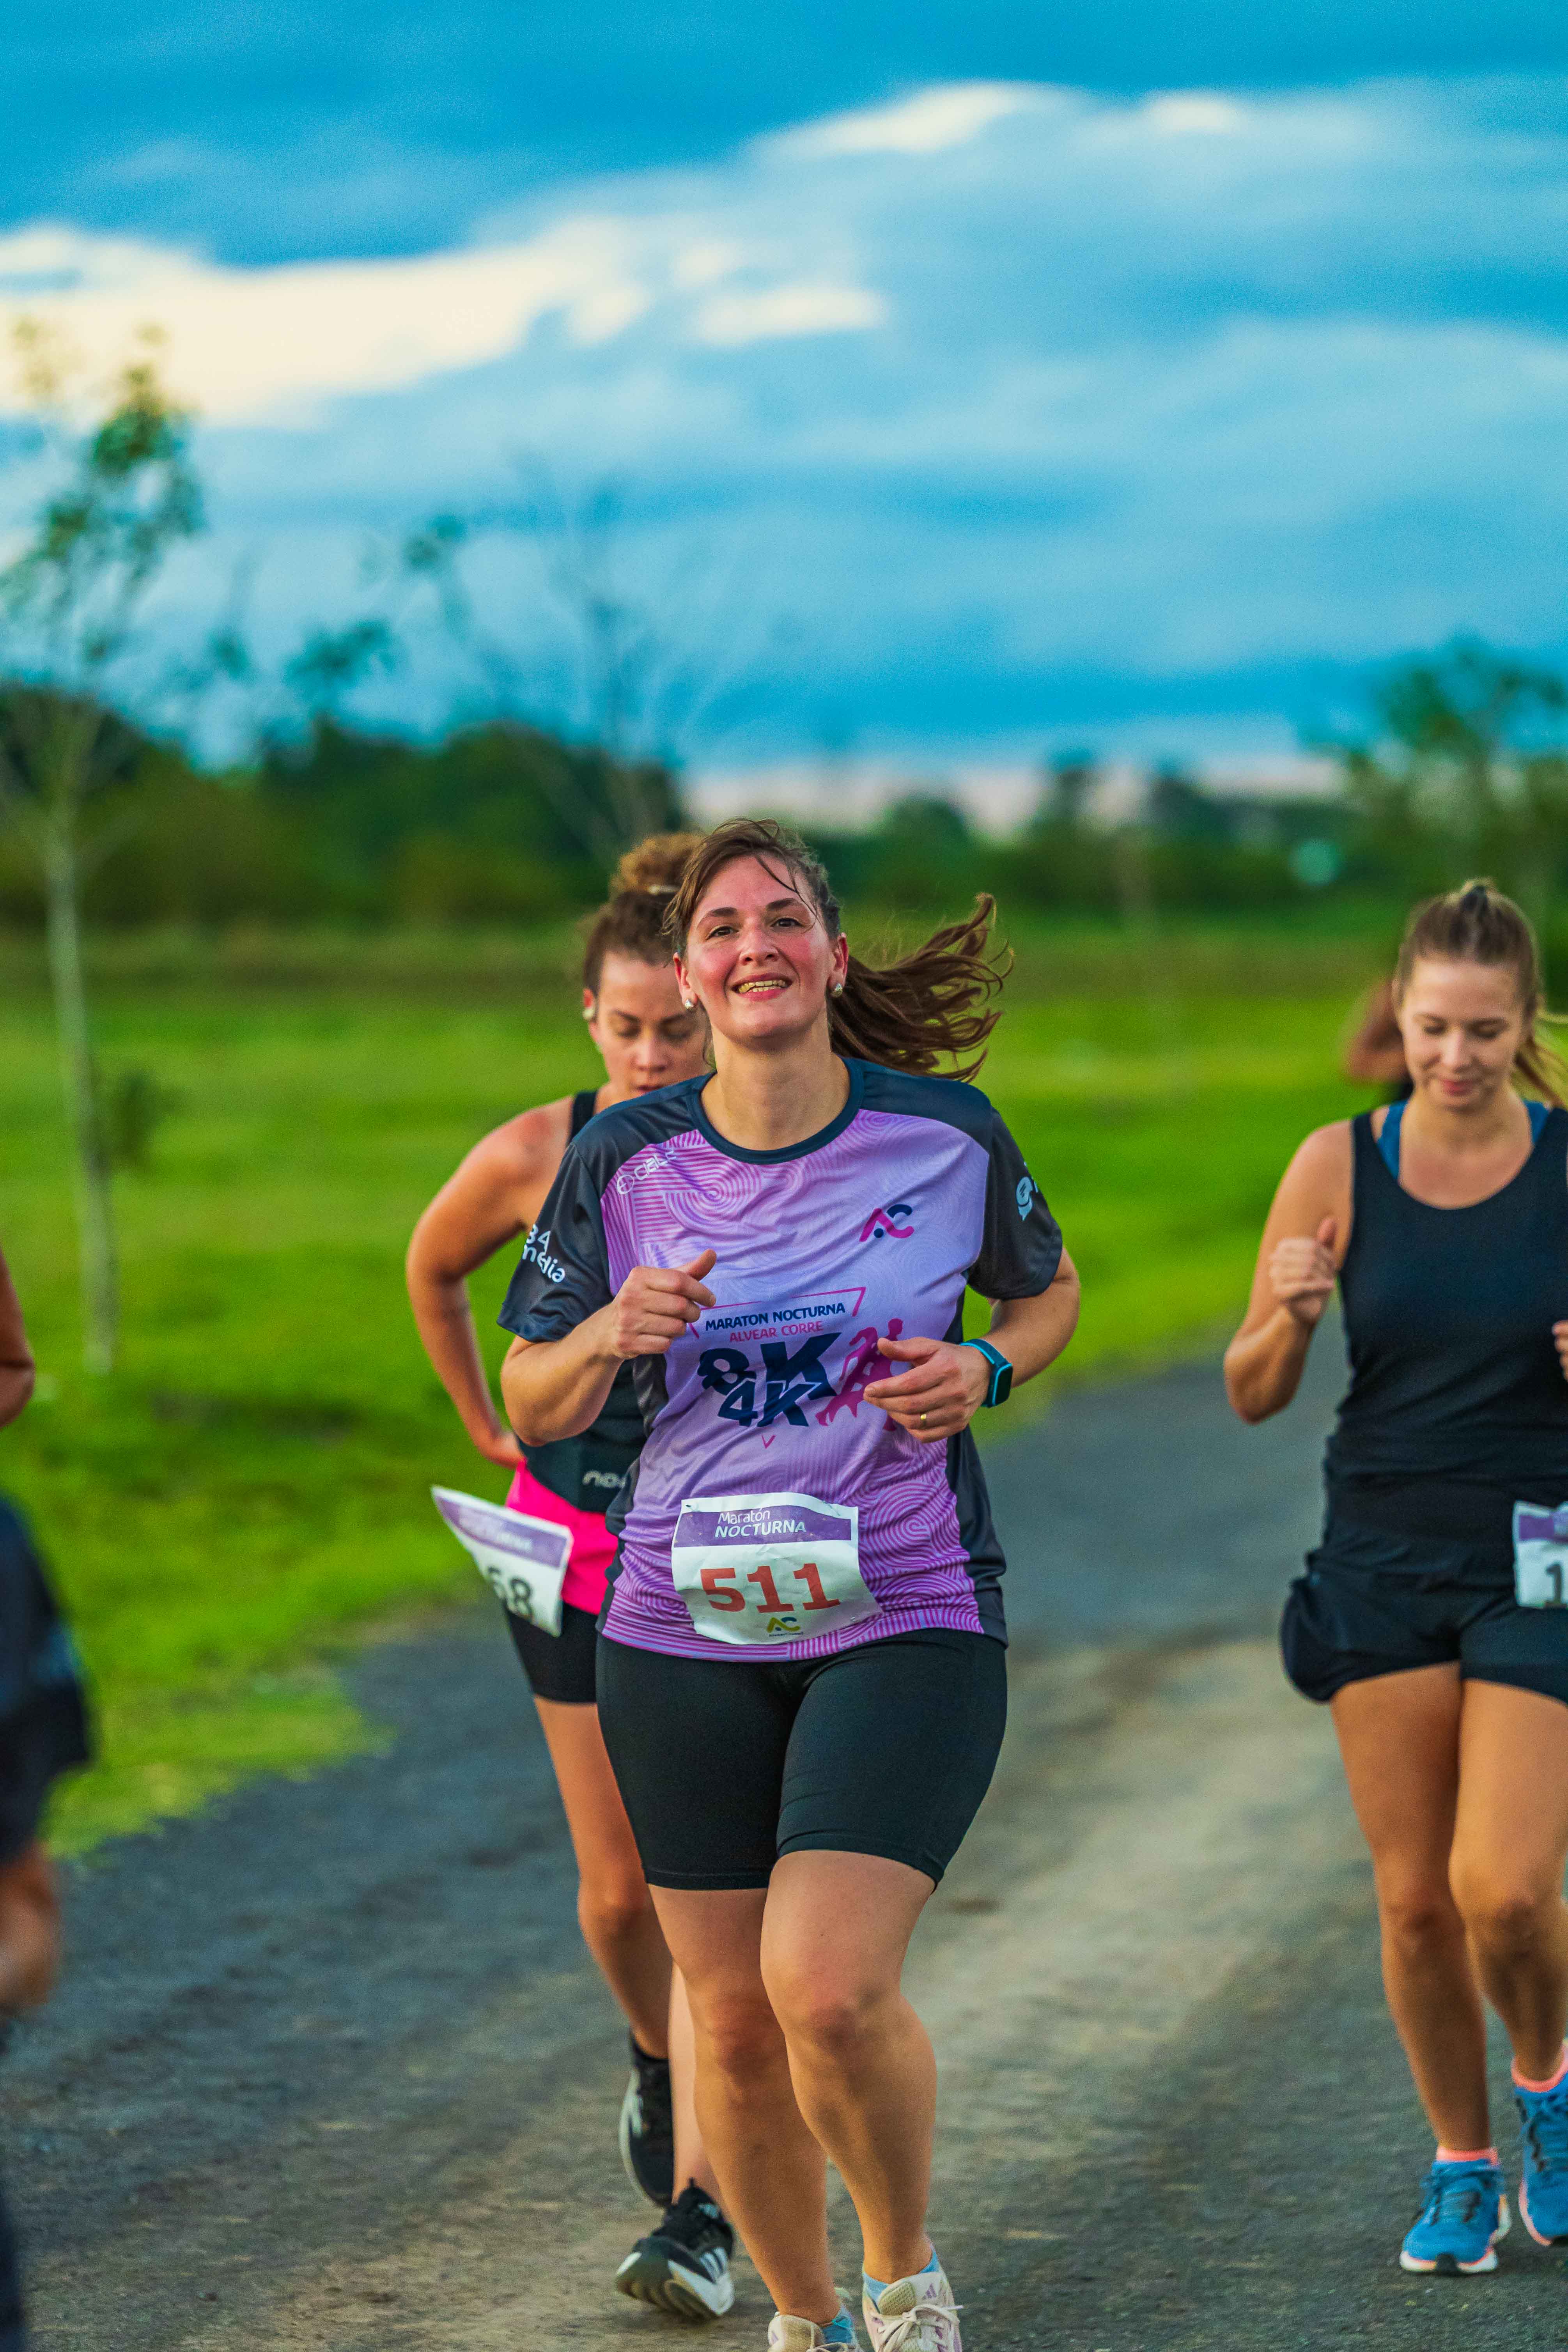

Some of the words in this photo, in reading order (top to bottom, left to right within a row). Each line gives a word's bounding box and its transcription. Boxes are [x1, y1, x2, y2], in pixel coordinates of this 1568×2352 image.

[705, 1312, 768, 1331] MARATON
[773, 1303, 845, 1323] NOCTURNA
[730, 1327, 778, 1342] ALVEAR
[781, 1321, 824, 1336] CORRE
[697, 1332, 842, 1400] 8K
[718, 1380, 817, 1427] 4K
[714, 1520, 806, 1538] NOCTURNA
[718, 1508, 771, 1525] Maratón
[700, 1563, 840, 1613] 511
